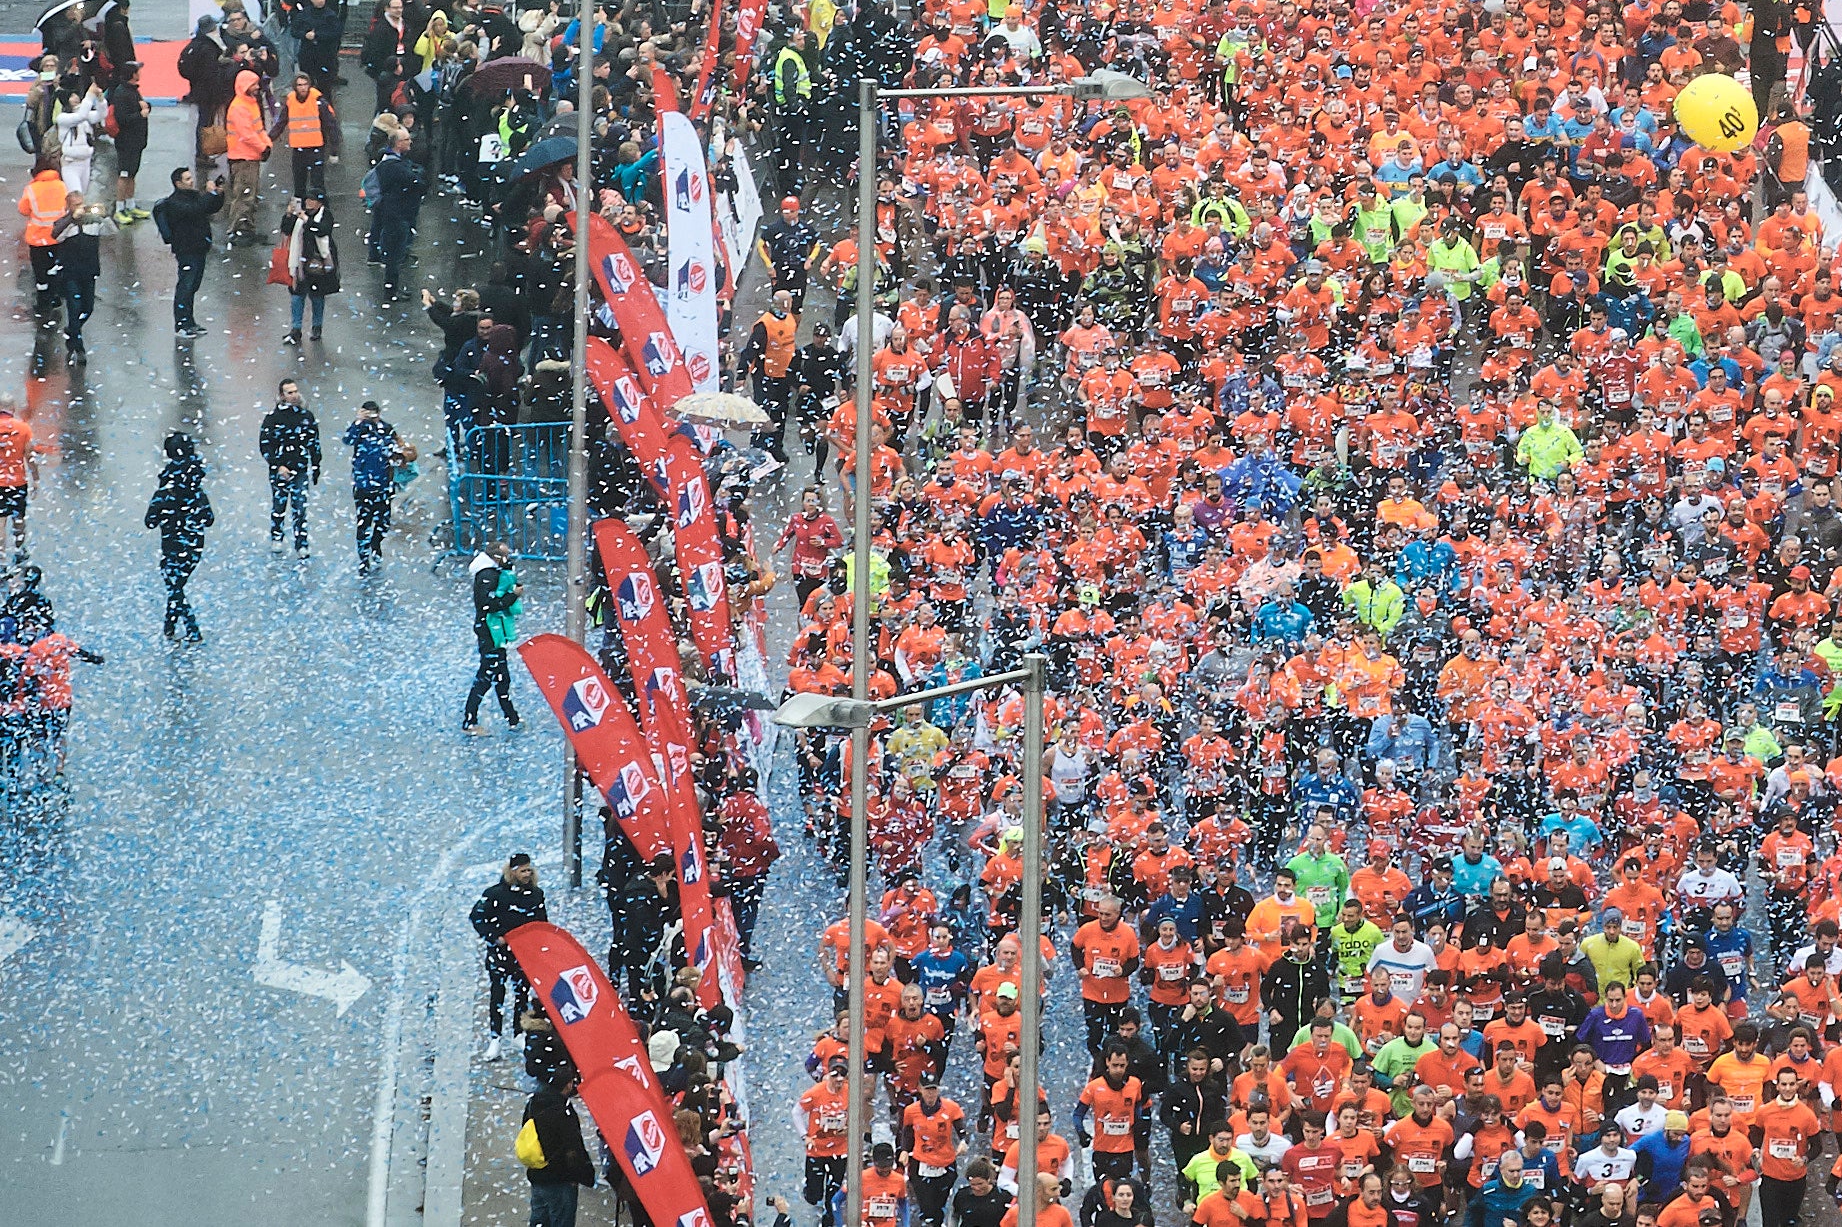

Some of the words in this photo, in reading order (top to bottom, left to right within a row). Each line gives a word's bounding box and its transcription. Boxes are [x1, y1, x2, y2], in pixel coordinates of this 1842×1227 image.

[1694, 882, 1708, 895] 3
[1632, 1118, 1645, 1132] 3
[1602, 1163, 1614, 1178] 3
